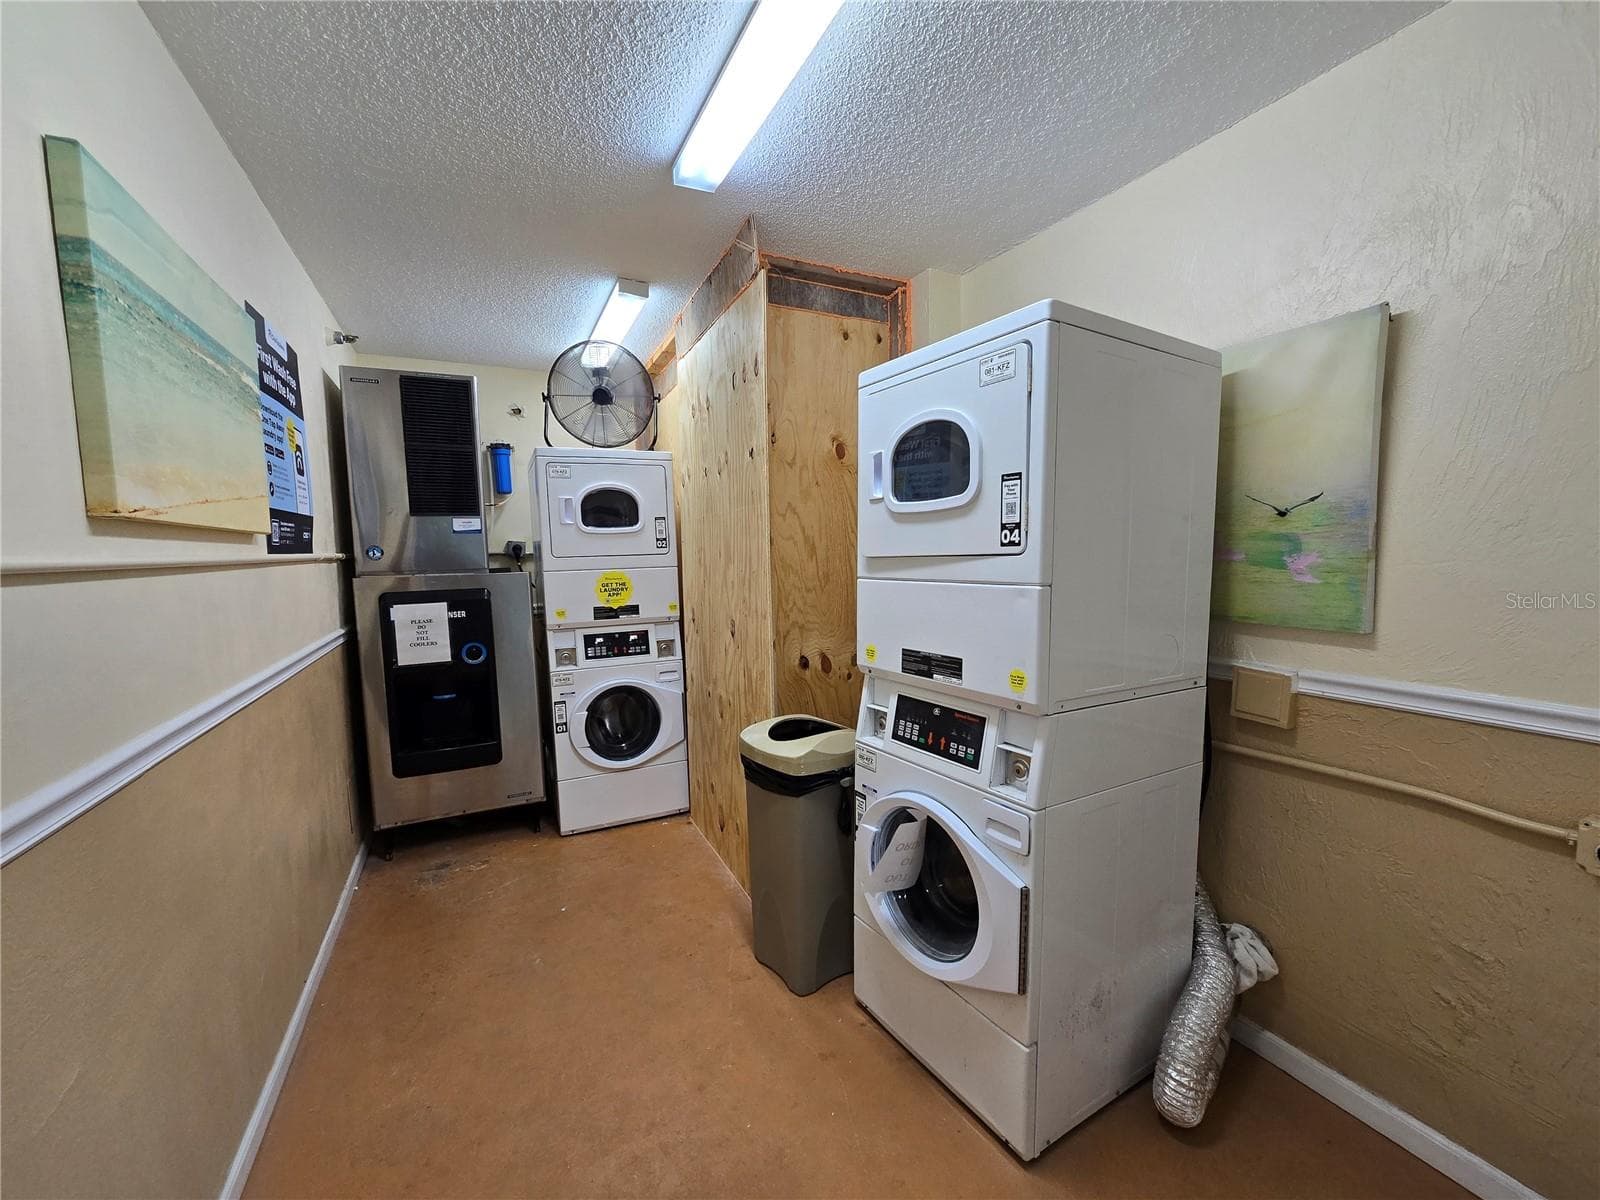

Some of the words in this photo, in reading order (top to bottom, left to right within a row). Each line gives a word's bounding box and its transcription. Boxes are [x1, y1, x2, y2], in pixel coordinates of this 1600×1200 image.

[272, 356, 287, 381] Wash
[263, 370, 277, 391] with
[656, 540, 667, 548] 02
[1001, 529, 1020, 544] 04
[557, 725, 566, 733] 01
